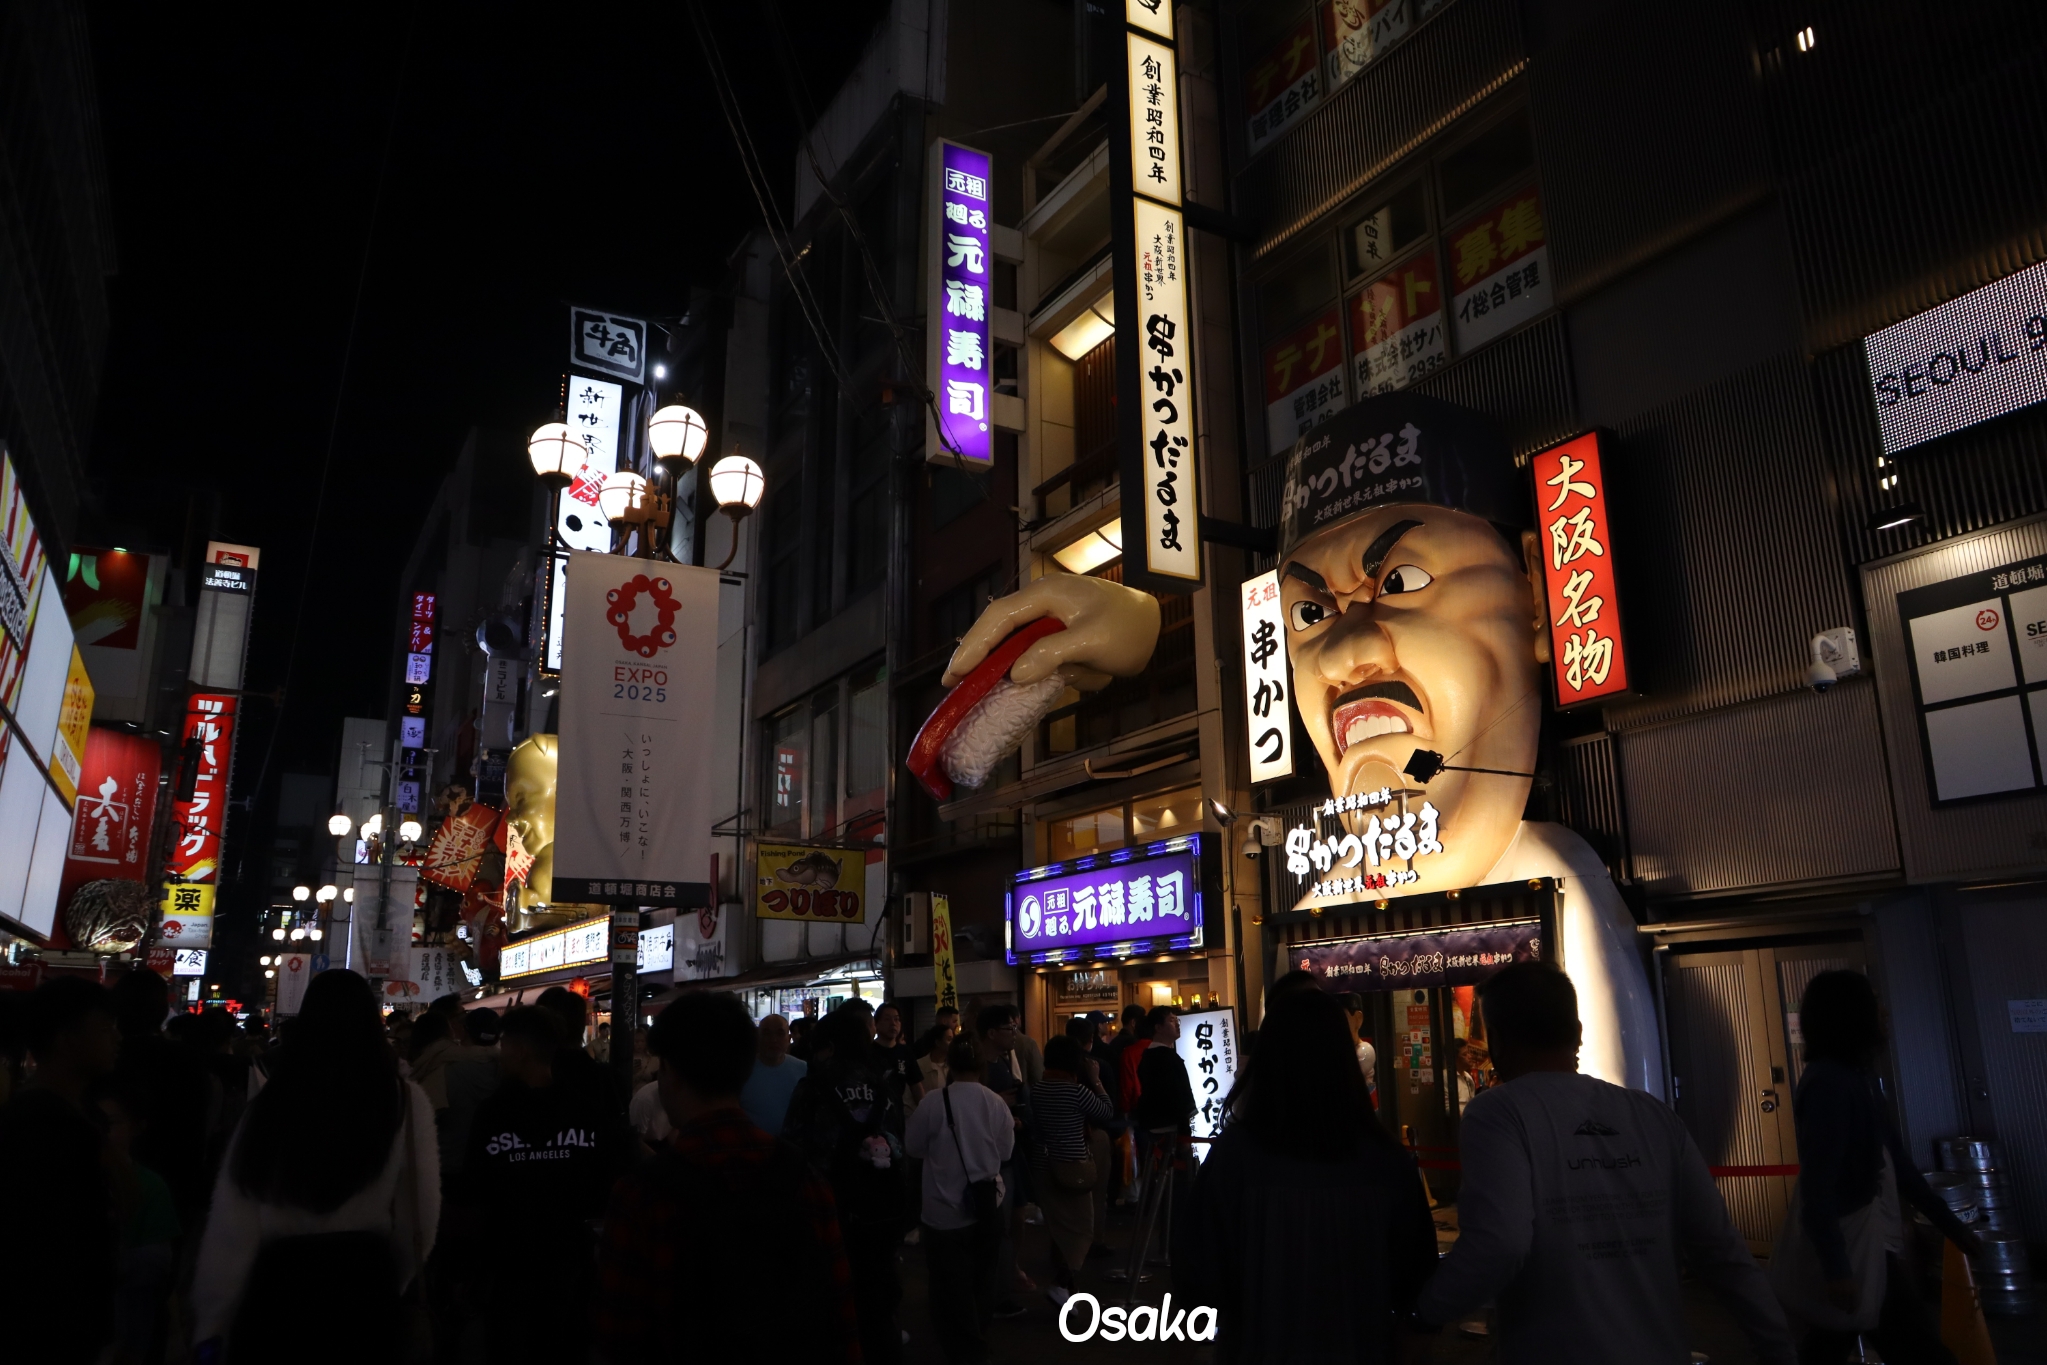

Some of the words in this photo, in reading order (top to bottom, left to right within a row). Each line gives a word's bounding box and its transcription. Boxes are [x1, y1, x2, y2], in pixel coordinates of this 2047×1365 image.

[1140, 54, 1167, 183] 創業昭和四年
[1252, 73, 1318, 142] 管理会社
[946, 167, 986, 200] 元祖
[1164, 220, 1177, 281] 創業昭和四年
[1454, 196, 1545, 285] 募集
[1153, 234, 1166, 287] 大阪新世界
[1143, 252, 1154, 301] 元祖串かつ
[947, 233, 985, 421] 元禄寿司
[585, 323, 636, 362] 牛角
[1876, 333, 2020, 406] SEOUL
[1293, 375, 1343, 420] 管理会社
[1146, 314, 1188, 552] 串かつだるま
[1313, 476, 1422, 525] 大阪新世界元祖串かつ
[205, 577, 247, 589] 法善寺ビル
[1546, 454, 1614, 692] 大阪名物
[1991, 562, 2047, 592] 道頓堀
[1247, 581, 1278, 610] 元祖
[1933, 640, 1990, 664] 韓国料理
[614, 666, 668, 686] EXPO
[1250, 618, 1285, 764] 串かつ
[613, 684, 667, 702] 2025
[1322, 787, 1392, 816] 創業昭和四年
[1285, 801, 1444, 885] 串かつだるま
[588, 883, 676, 898] 道頓堀商店会
[1312, 870, 1418, 898] 大阪新世界元祖串かつ
[174, 888, 201, 911] 薬
[1046, 893, 1067, 909] 元祖
[1072, 870, 1184, 931] 元禄寿司
[1324, 963, 1372, 978] 創業昭和四年
[1380, 951, 1444, 980] 串かつだるま
[1446, 951, 1513, 969] 大阪新世界元祖串かつ
[1219, 1018, 1233, 1074] 創業昭和四年
[509, 1152, 526, 1163] LOS
[529, 1149, 570, 1160] ANGELES
[1567, 1154, 1642, 1171] unhusk
[1546, 1206, 1567, 1215] HOPE
[1601, 1213, 1611, 1221] TO
[1592, 1241, 1623, 1250] SECRET
